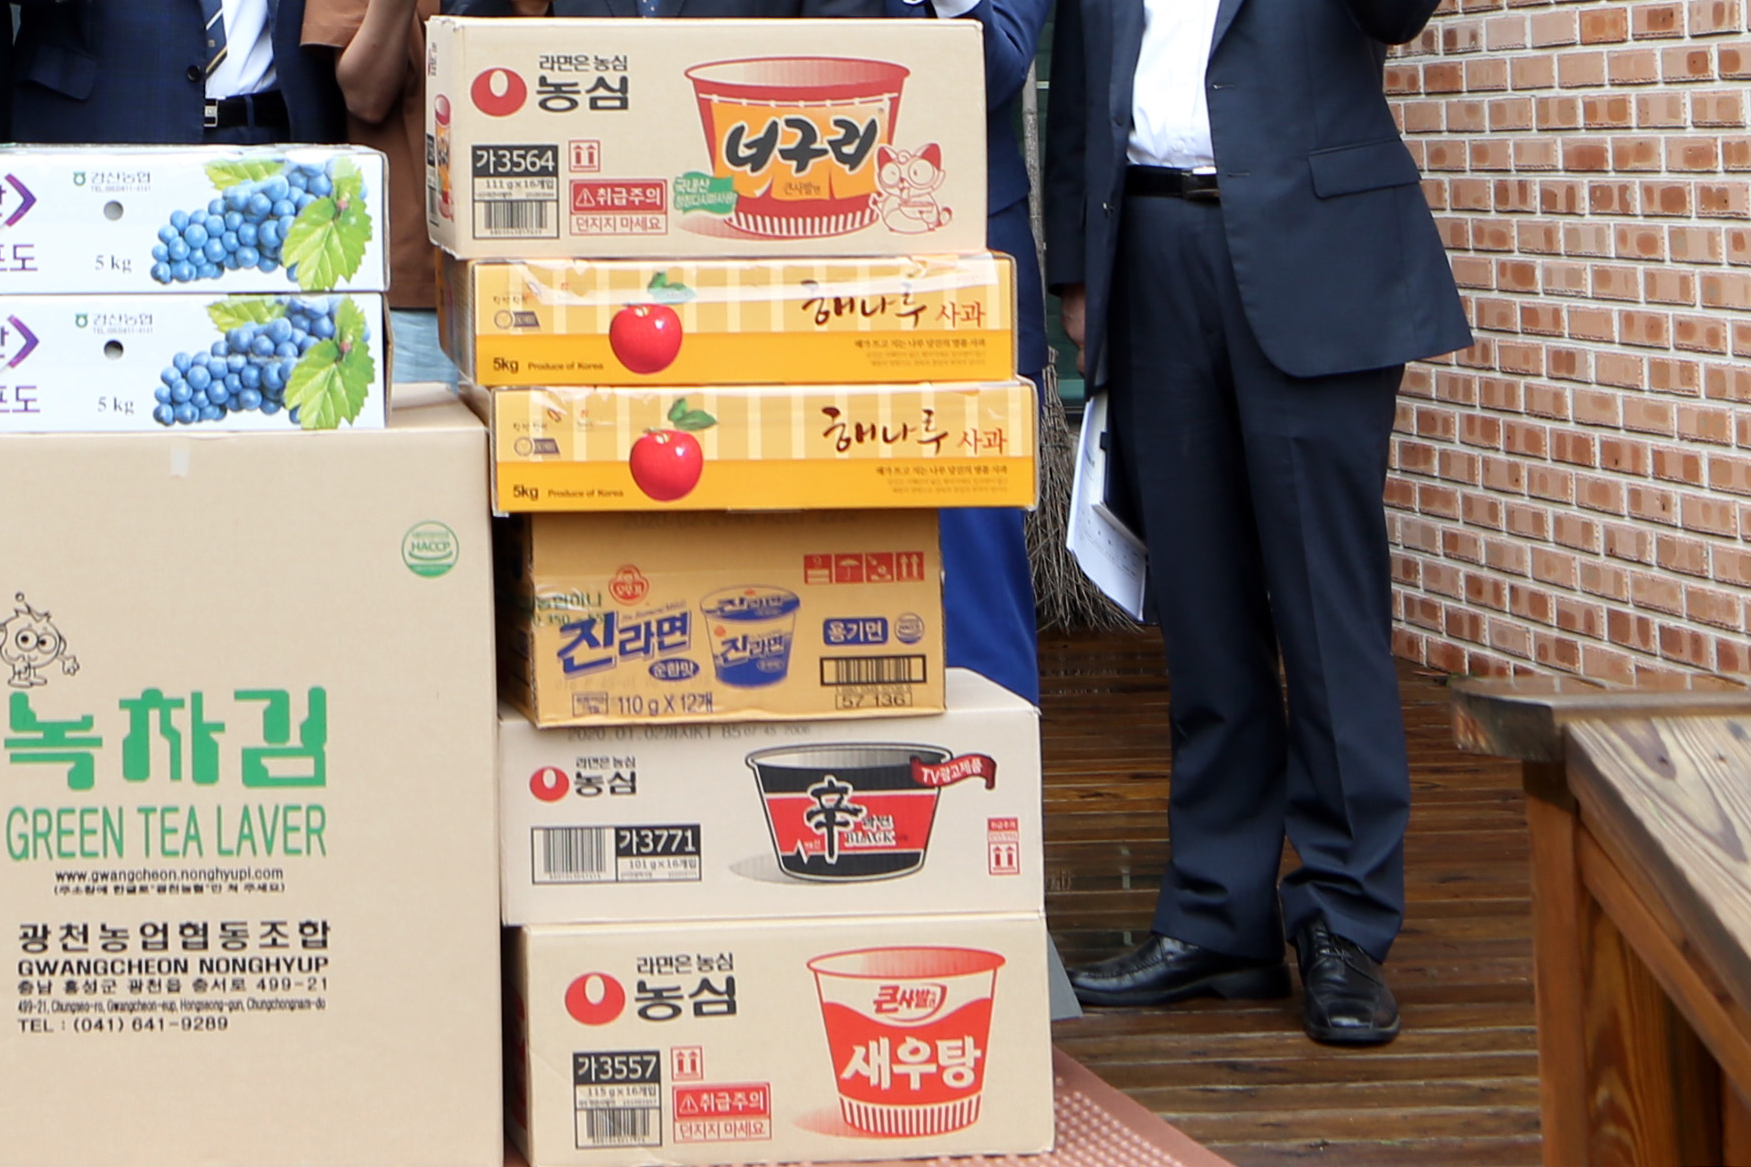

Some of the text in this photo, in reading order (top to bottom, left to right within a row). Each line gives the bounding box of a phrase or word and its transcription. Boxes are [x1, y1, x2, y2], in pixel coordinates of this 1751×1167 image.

[539, 54, 629, 72] 라면은 농심
[536, 75, 630, 111] 농심
[726, 118, 878, 173] 너구리
[476, 149, 555, 174] 가3564
[597, 188, 661, 206] 취급주의
[576, 216, 661, 232] 던지지 마세요
[95, 255, 132, 273] 5 kg
[936, 301, 986, 328] 사과
[493, 357, 604, 374] 5kg Produce of Korea
[97, 397, 134, 415] 5 kg
[822, 406, 1008, 455] 해나루 사과
[513, 485, 624, 501] 5kg Produce of Korea
[411, 541, 450, 552] HACCP
[828, 620, 883, 643] 용기면
[556, 611, 692, 679] 진라면
[721, 632, 785, 662] 진라면
[653, 662, 695, 678] 순한맛
[618, 694, 643, 714] 110
[648, 698, 659, 716] g
[664, 694, 675, 713] X
[681, 692, 714, 713] 12개
[842, 694, 906, 708] 57 136
[4, 686, 328, 790] 녹차김
[575, 755, 637, 769] 라면은 농심
[574, 771, 637, 797] 농심
[806, 777, 864, 860] 辛
[6, 802, 327, 861] GREEN TEA LAVER
[619, 829, 696, 855] 가3771
[845, 831, 895, 846] BLACK
[18, 920, 331, 954] 광천농업협동조합
[18, 956, 329, 977] GWANGCHEON NONGHYUP
[637, 952, 735, 975] 라면은 농심
[256, 977, 328, 992] 499-21
[635, 977, 738, 1021] 농심
[18, 1018, 54, 1033] TEL
[73, 1017, 124, 1032] (041)
[132, 1016, 229, 1031] 641-9289
[578, 1055, 657, 1082] 가3557
[840, 1034, 982, 1091] 새우탕
[701, 1091, 764, 1111] 취급주의
[680, 1120, 765, 1139] 던지지 마세요
